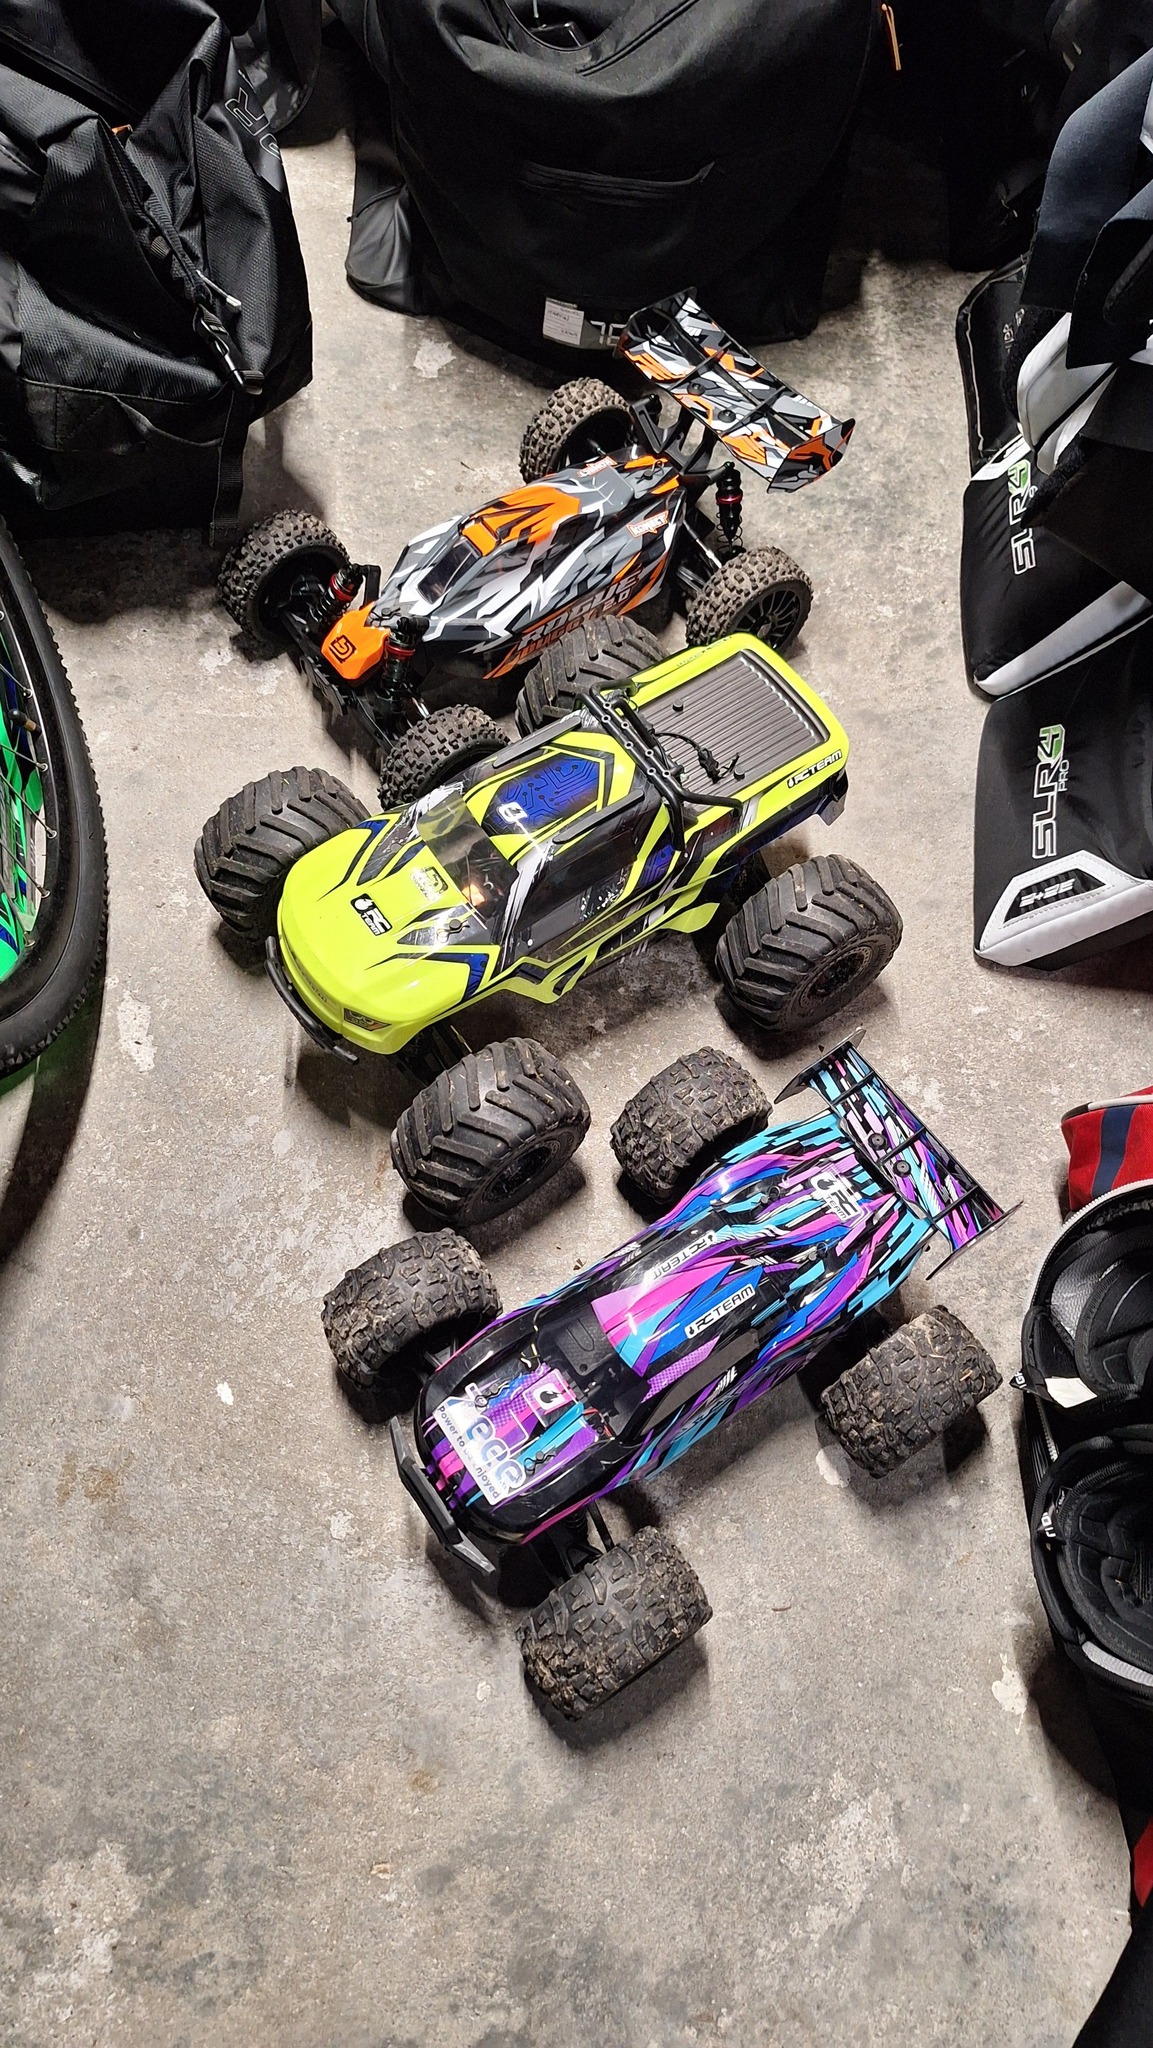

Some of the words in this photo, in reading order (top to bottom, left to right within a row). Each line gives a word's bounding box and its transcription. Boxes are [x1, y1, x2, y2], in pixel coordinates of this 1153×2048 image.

[517, 568, 643, 651] ROGUE
[602, 590, 632, 612] 2.0
[809, 750, 842, 774] TEAM
[1058, 759, 1071, 792] PRO
[1032, 724, 1066, 859] SLR4
[361, 913, 381, 936] TEAM
[826, 1195, 847, 1219] TEAM
[713, 1286, 754, 1317] TEAM
[438, 1405, 459, 1436] Power
[456, 1435, 466, 1448] to
